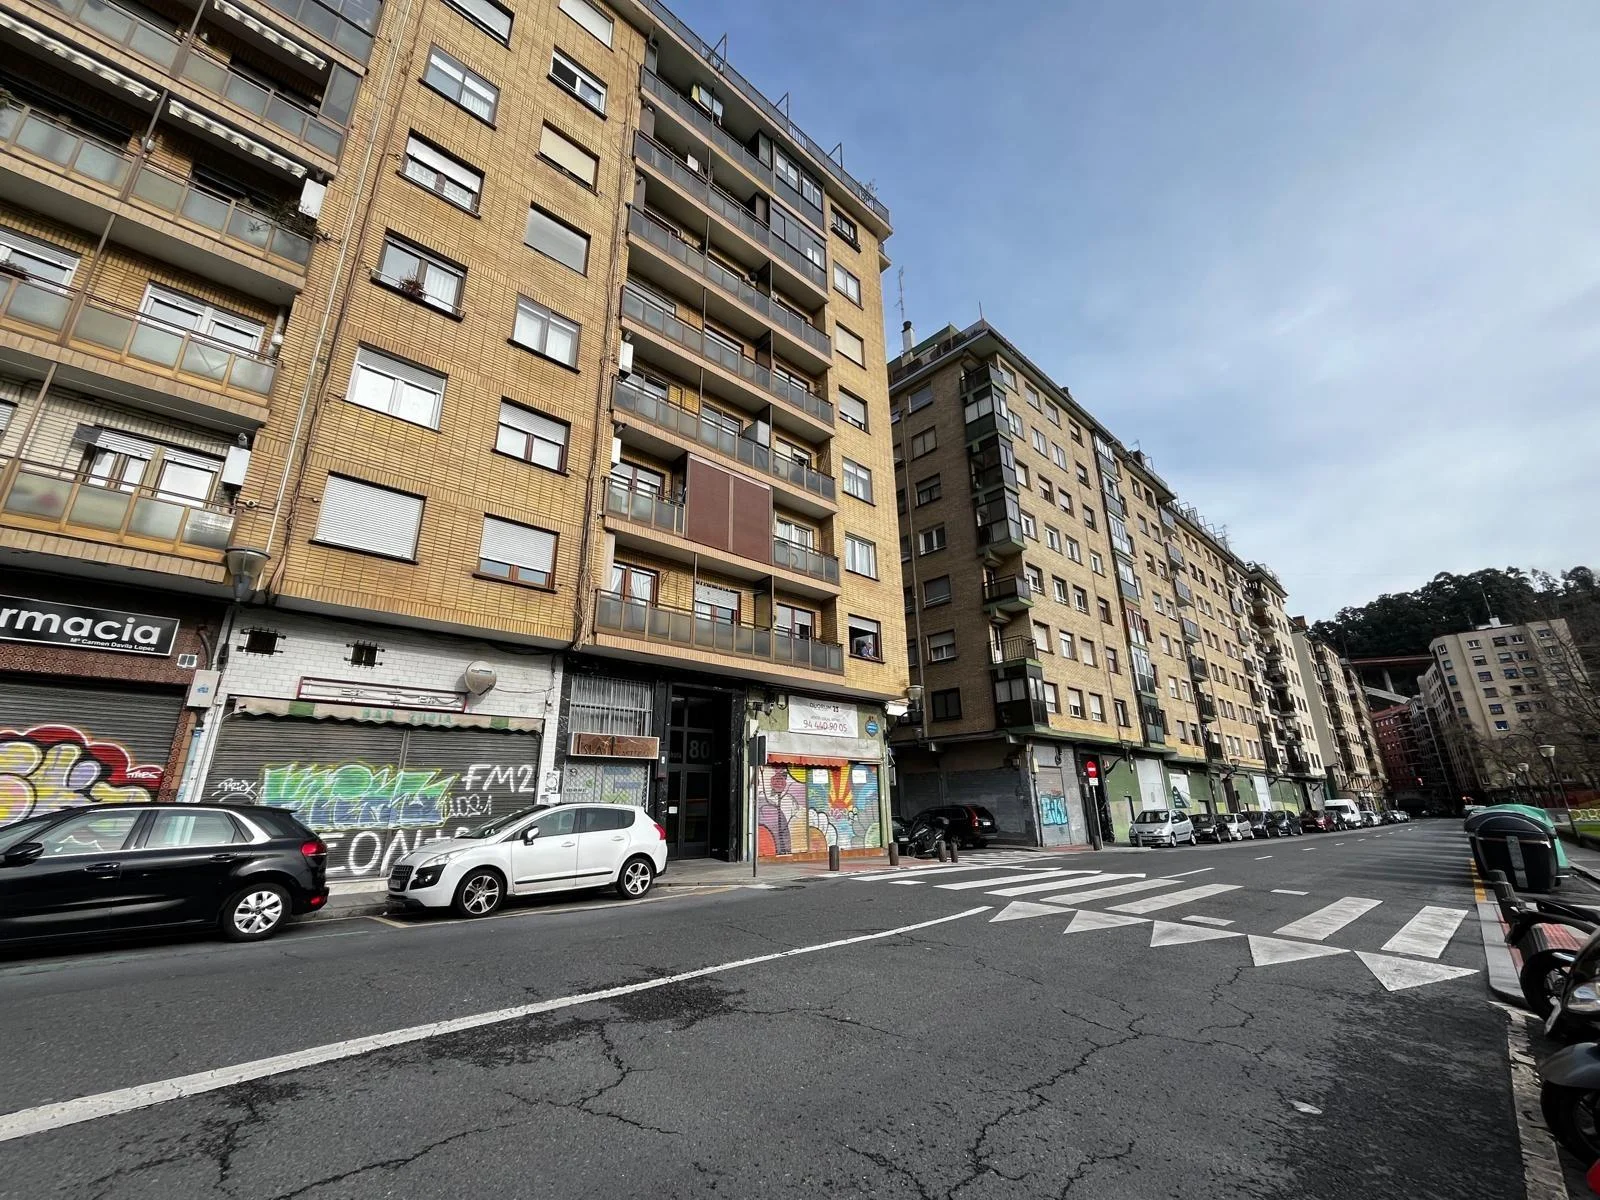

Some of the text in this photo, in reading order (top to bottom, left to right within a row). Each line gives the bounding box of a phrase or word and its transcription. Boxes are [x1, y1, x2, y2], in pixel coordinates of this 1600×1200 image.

[82, 638, 110, 647] Carmen
[362, 707, 394, 719] BAR
[689, 740, 710, 758] 80
[461, 764, 534, 792] FM2
